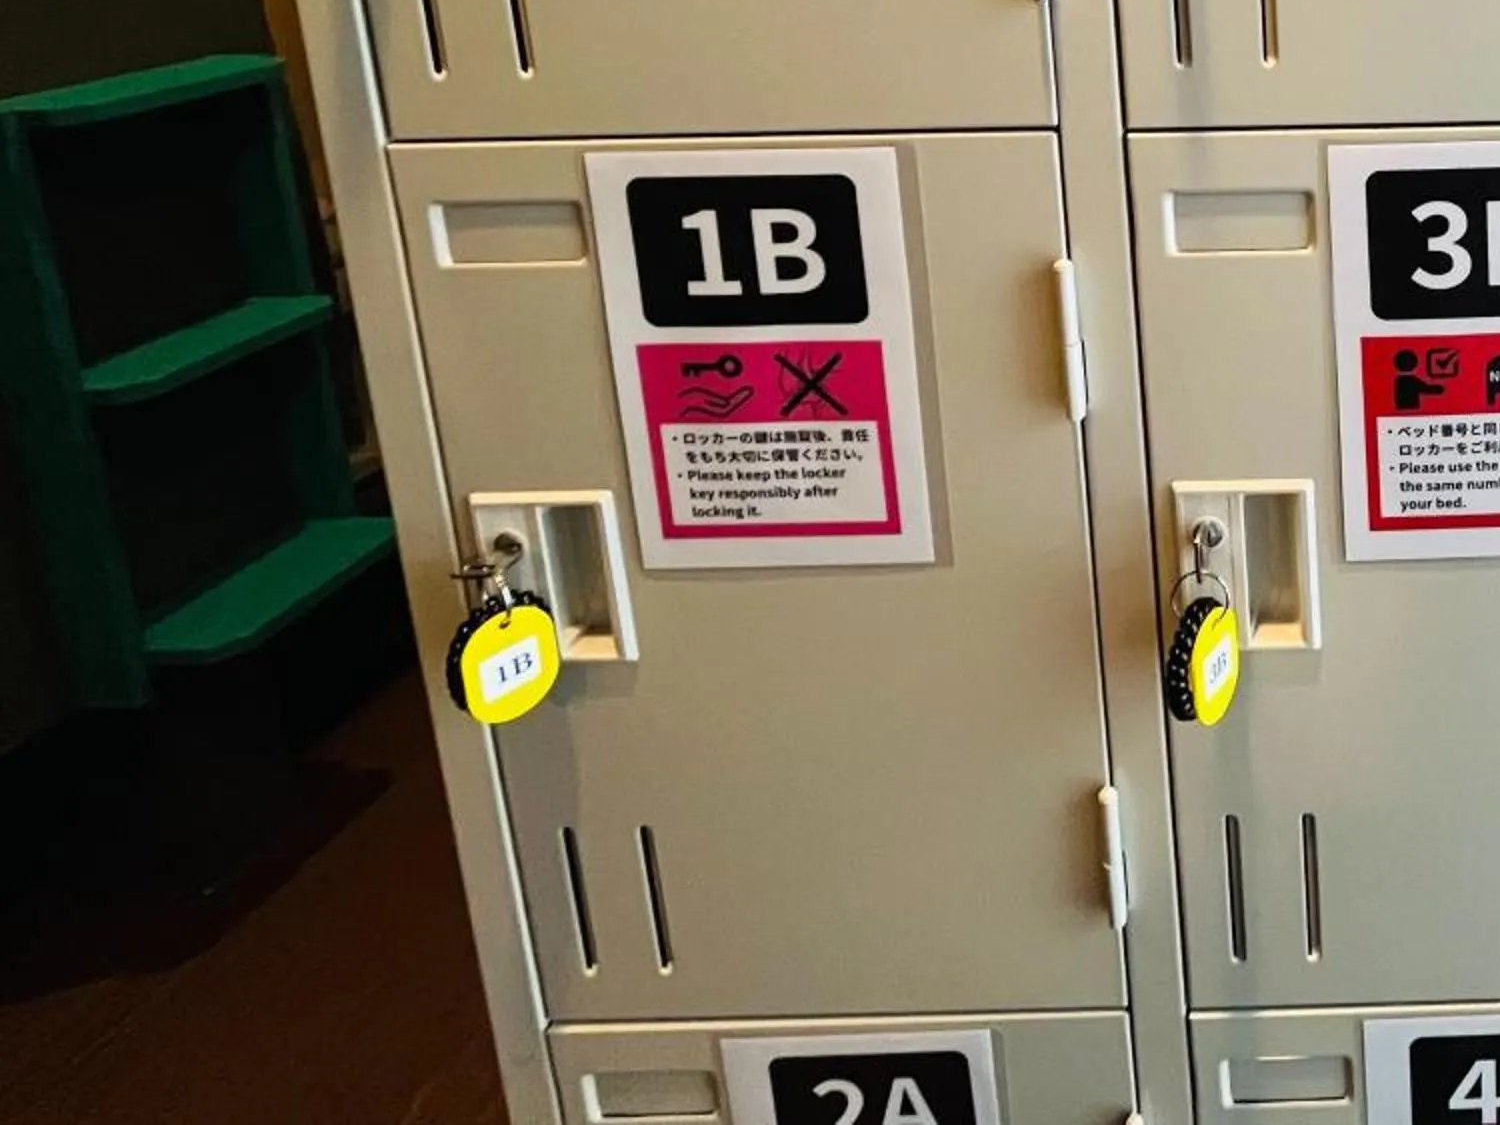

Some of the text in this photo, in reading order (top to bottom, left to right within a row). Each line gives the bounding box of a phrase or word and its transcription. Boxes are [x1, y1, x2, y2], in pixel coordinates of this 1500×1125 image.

[681, 208, 826, 296] 1B
[688, 467, 846, 482] Please keep the locker
[1400, 462, 1444, 474] Please
[1449, 462, 1472, 473] use
[1476, 460, 1498, 472] the
[690, 485, 837, 500] key responsibly after
[1400, 481, 1423, 492] the
[1427, 481, 1463, 491] same
[1400, 497, 1467, 512] your bed.
[692, 506, 762, 519] locking it.
[498, 652, 533, 683] 1B
